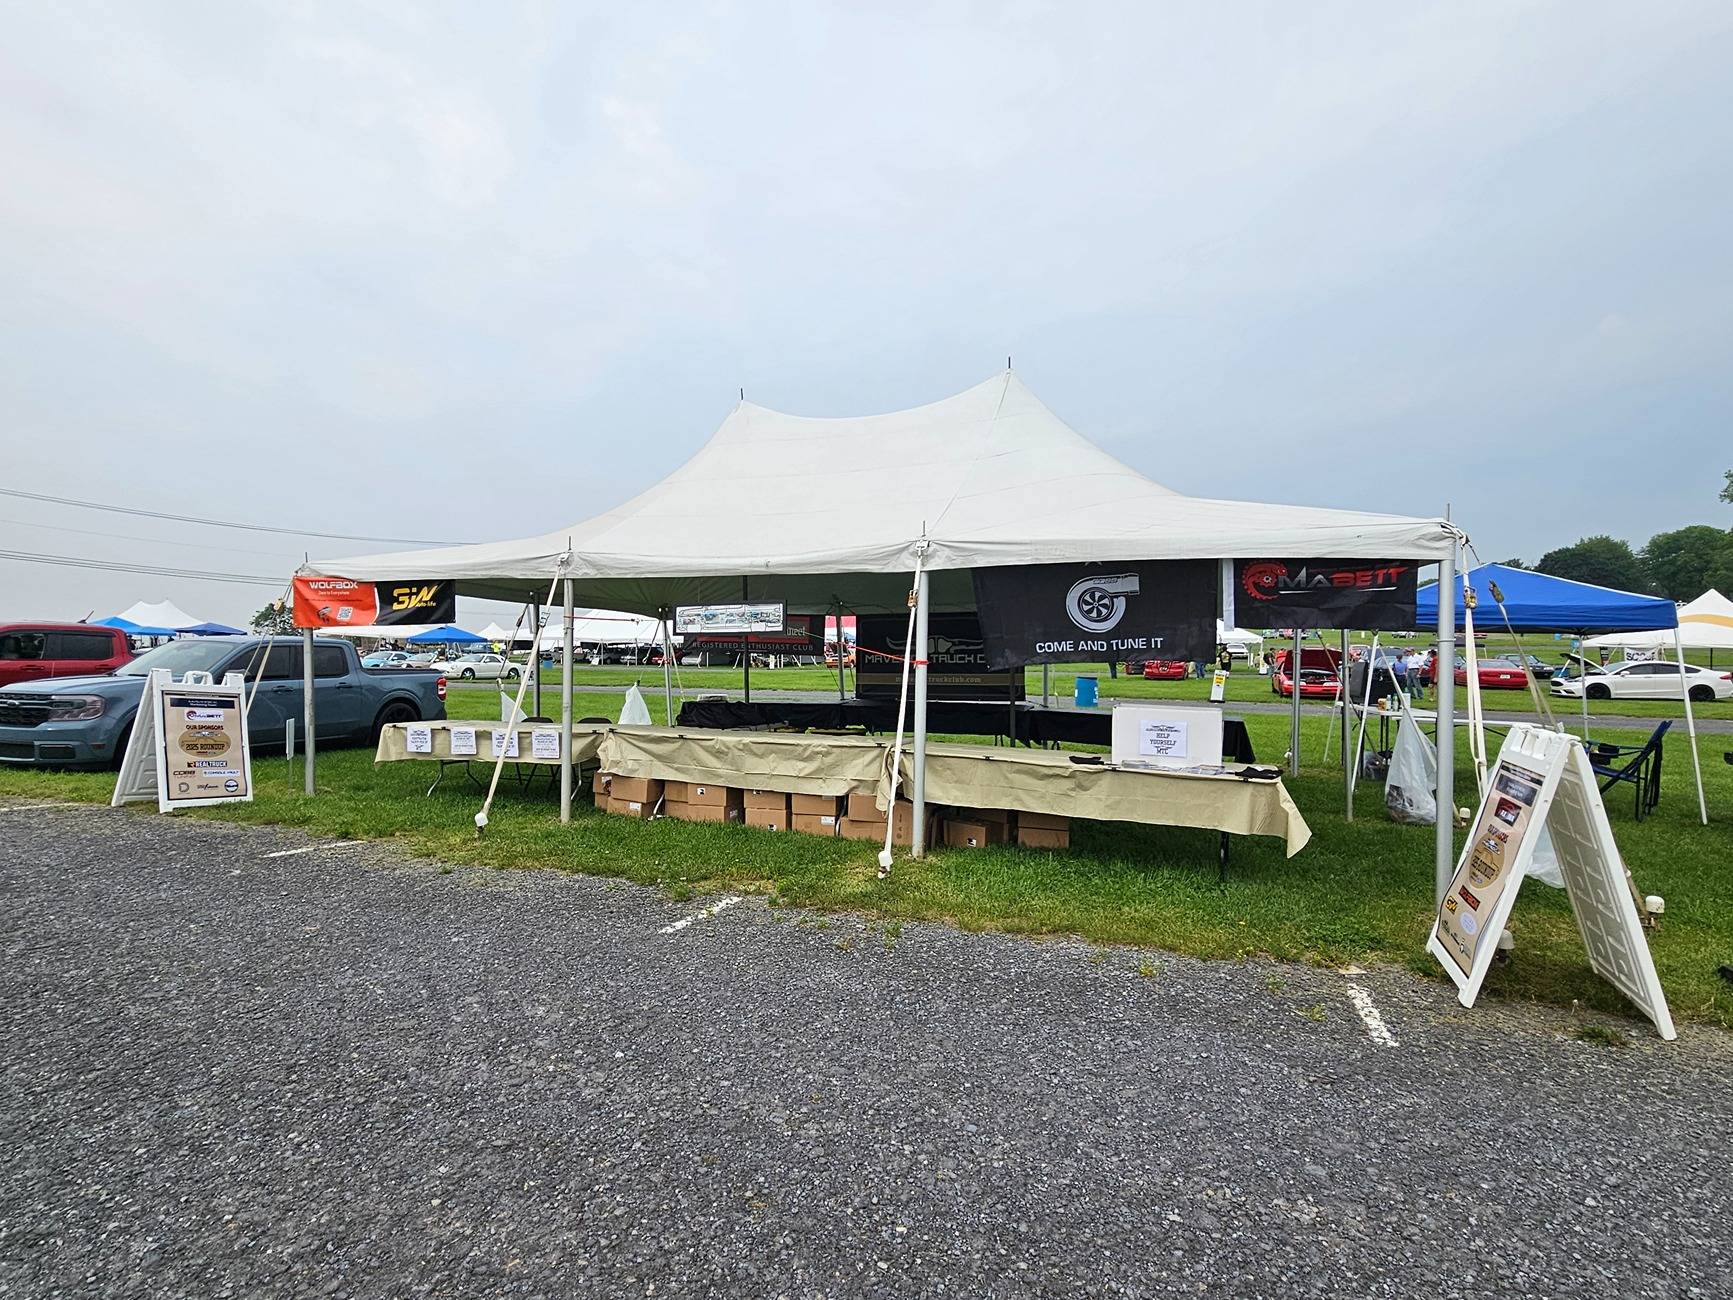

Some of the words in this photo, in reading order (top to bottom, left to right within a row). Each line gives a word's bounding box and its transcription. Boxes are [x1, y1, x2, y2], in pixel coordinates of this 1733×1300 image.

[1278, 566, 1408, 588] MABETT
[309, 581, 359, 589] WOLFBOX
[1036, 640, 1074, 653] COME
[1078, 640, 1107, 651] AND
[1110, 638, 1147, 651] TUNE
[1151, 637, 1163, 649] IT
[931, 654, 975, 664] TRUCK
